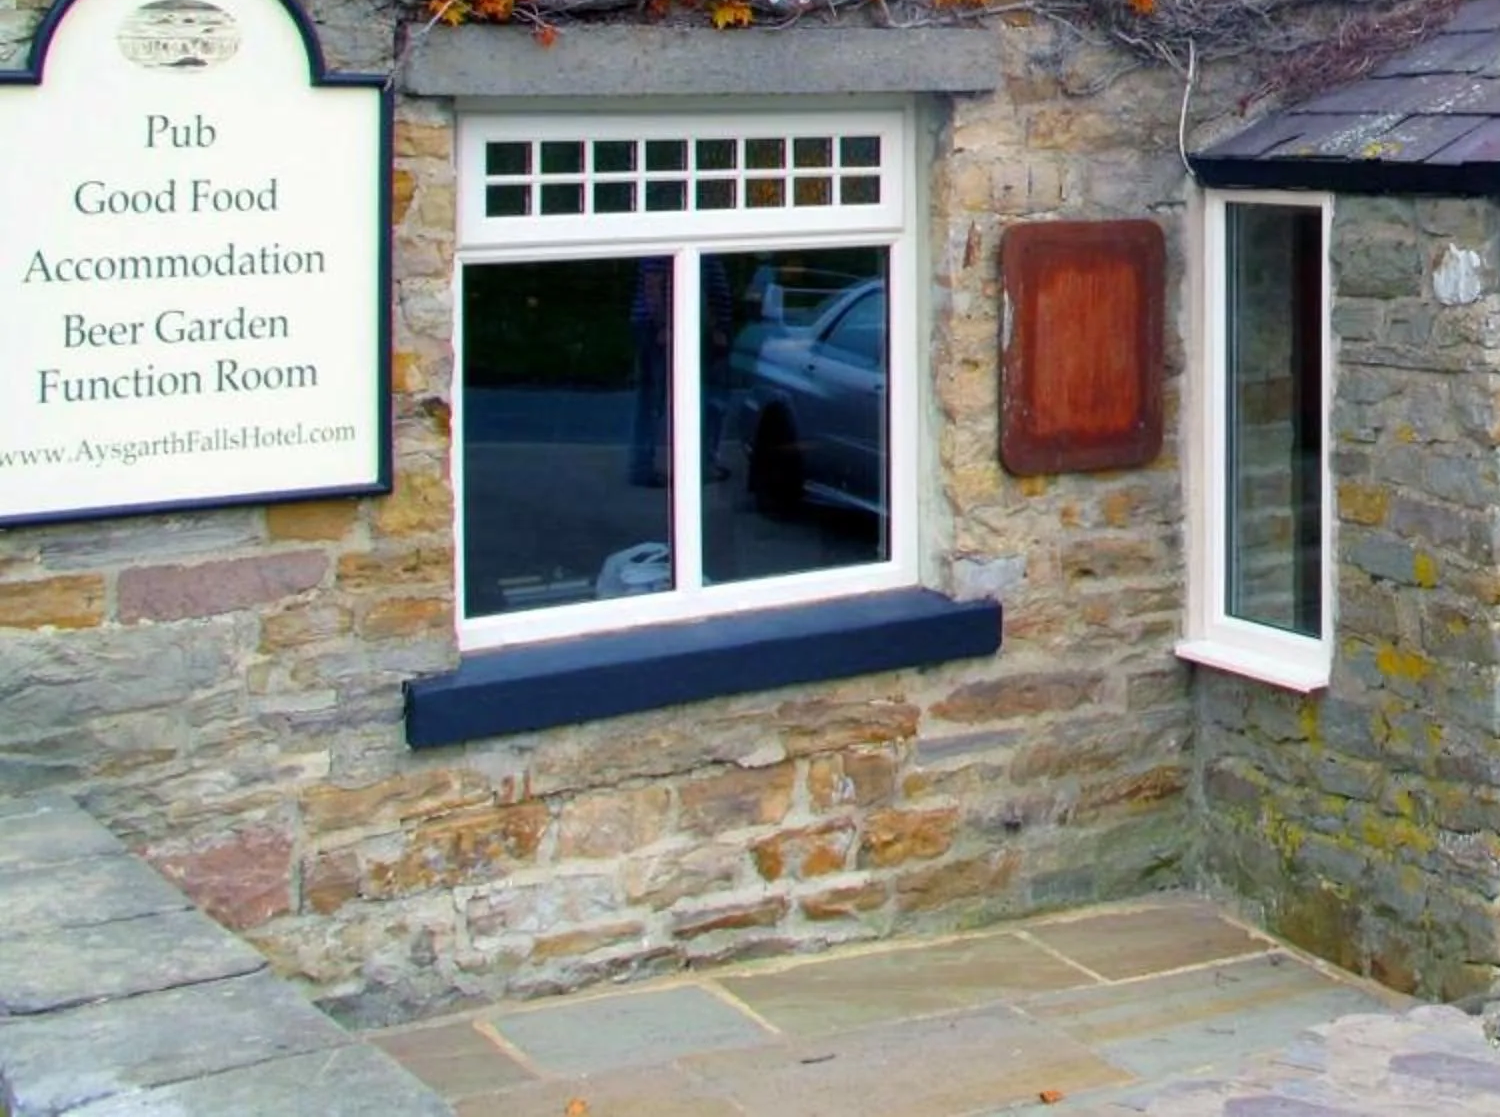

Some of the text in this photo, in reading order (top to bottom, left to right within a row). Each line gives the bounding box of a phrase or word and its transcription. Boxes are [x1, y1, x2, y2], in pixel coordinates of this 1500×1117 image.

[145, 115, 216, 148] Pub
[74, 178, 278, 215] Good Food
[22, 243, 325, 283] Accommodation
[64, 307, 289, 348] Beer Garden
[38, 359, 318, 403] Function Room
